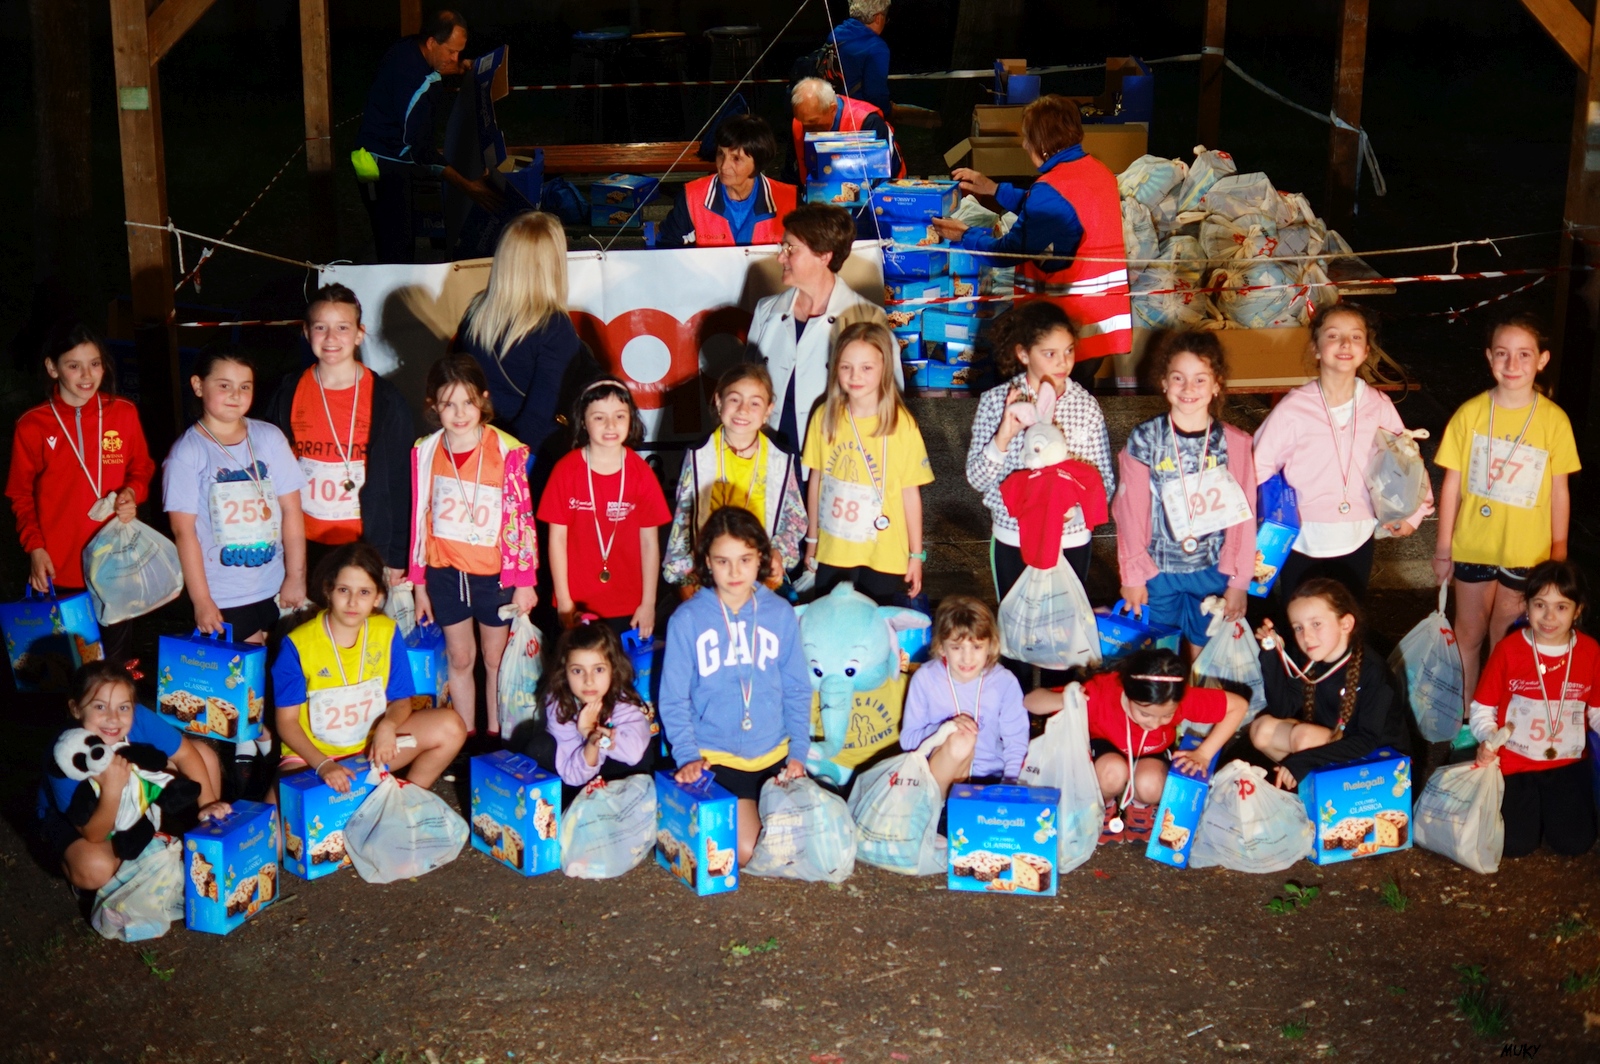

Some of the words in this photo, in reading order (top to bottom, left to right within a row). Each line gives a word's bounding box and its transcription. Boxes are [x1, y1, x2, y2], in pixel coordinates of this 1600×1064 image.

[1489, 457, 1524, 484] 57
[308, 477, 352, 502] 102
[1189, 487, 1226, 515] 92
[438, 497, 490, 528] 270
[831, 496, 859, 523] 58
[696, 620, 779, 678] GAP
[183, 681, 214, 693] CLASSICA
[325, 698, 373, 731] 257
[1529, 718, 1565, 744] 52
[906, 778, 919, 786] TU
[1349, 803, 1383, 815] CLASSICA
[983, 841, 1022, 851] CLASSICA
